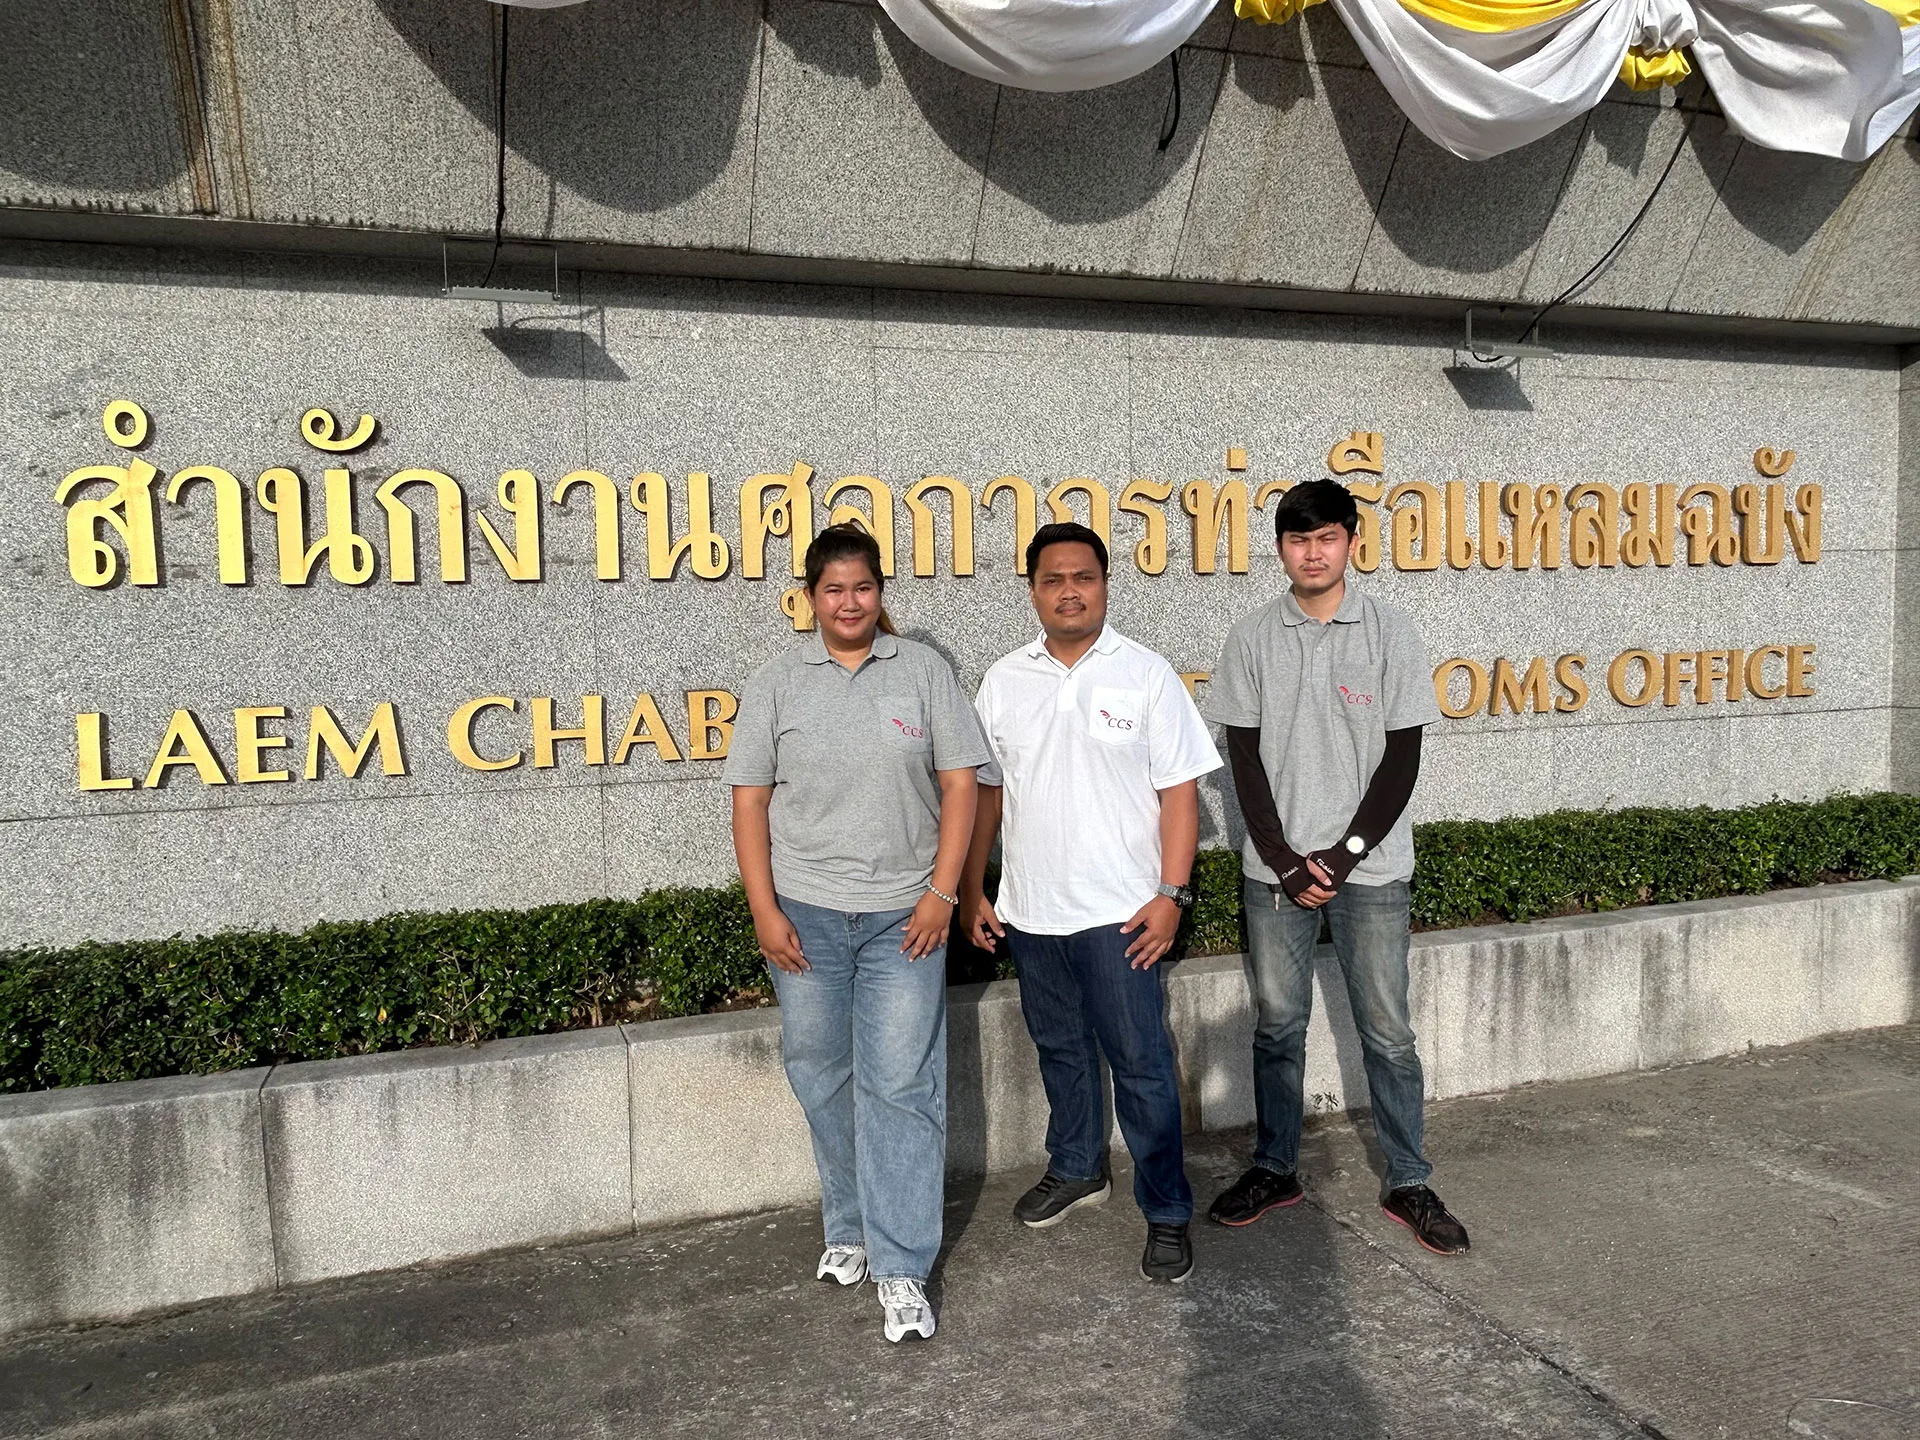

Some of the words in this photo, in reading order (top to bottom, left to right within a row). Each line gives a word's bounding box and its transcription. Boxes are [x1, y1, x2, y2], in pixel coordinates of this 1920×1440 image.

[1346, 693, 1373, 706] CCS
[76, 702, 406, 791] LAEM
[448, 689, 738, 771] CHAB
[1608, 644, 1816, 707] OFFICE
[1107, 717, 1133, 731] CCS
[902, 725, 924, 739] CCS
